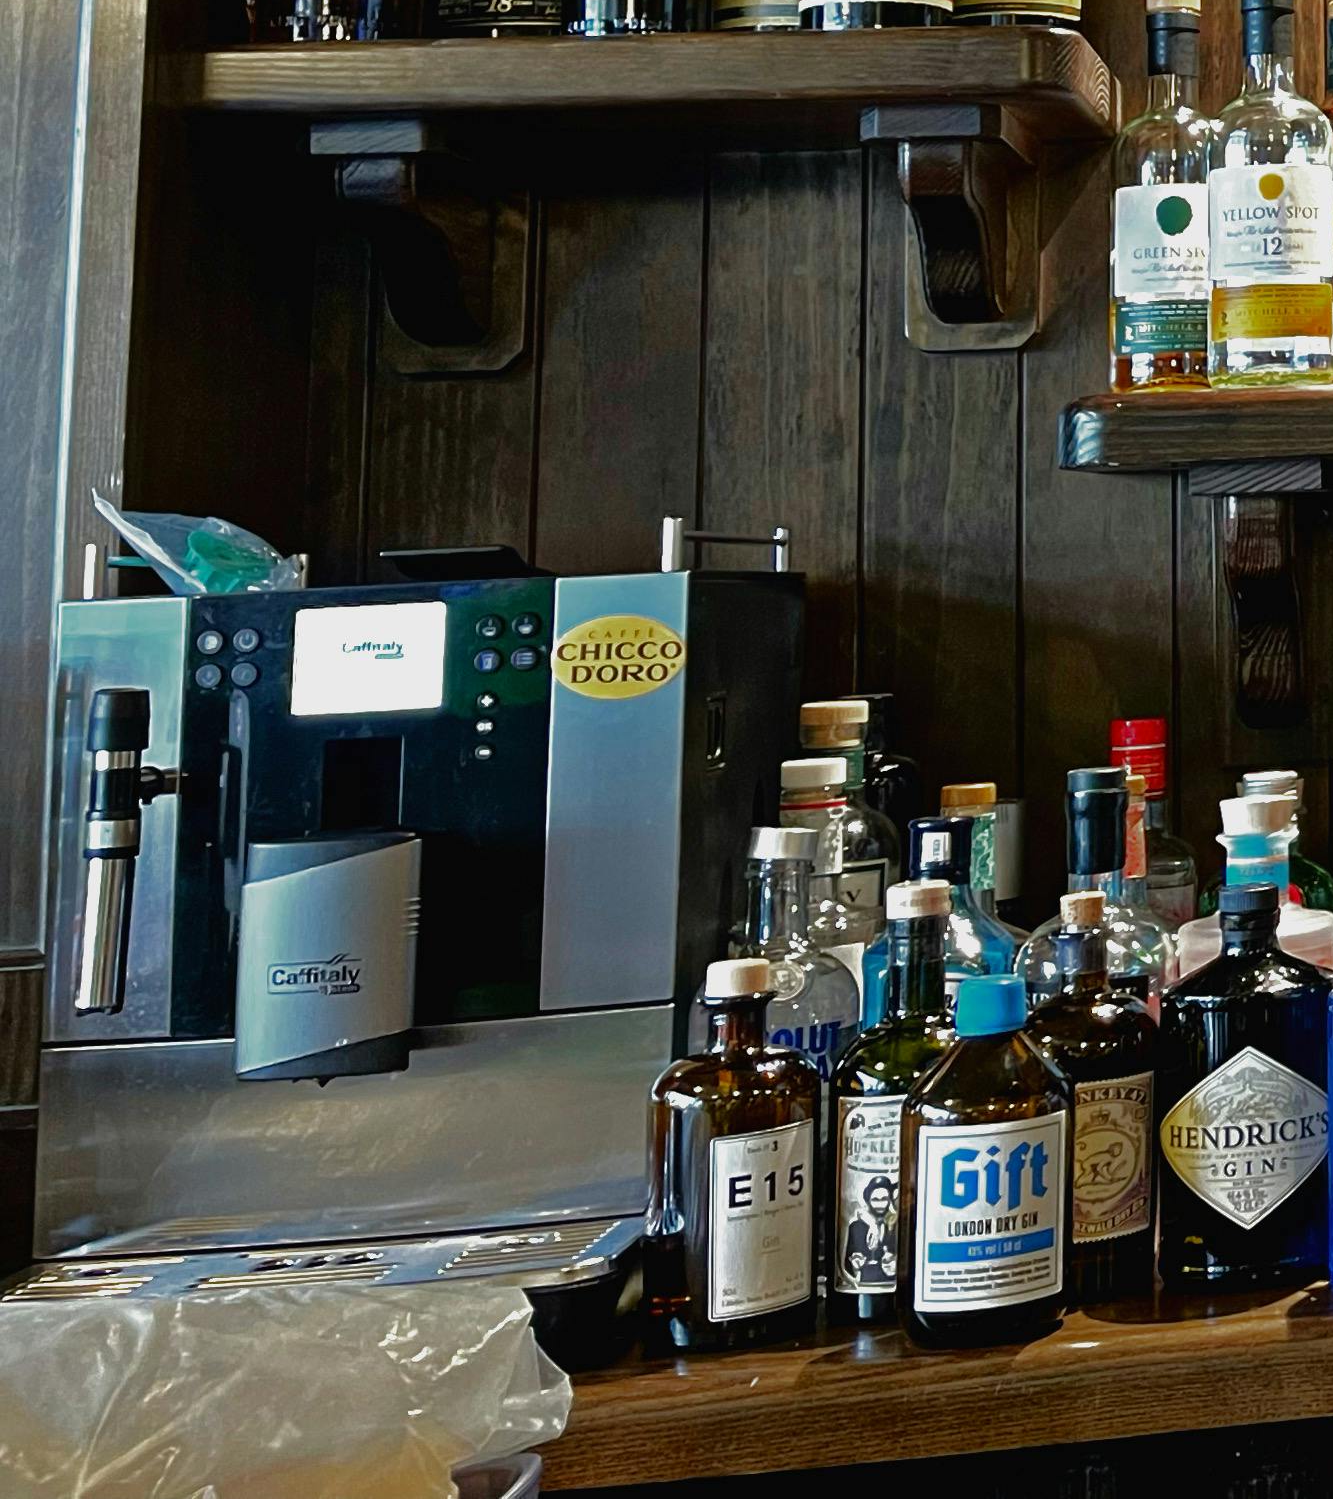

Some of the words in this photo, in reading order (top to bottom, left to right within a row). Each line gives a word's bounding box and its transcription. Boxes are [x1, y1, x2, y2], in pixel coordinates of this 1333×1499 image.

[1223, 206, 1281, 222] YELLOW
[1286, 207, 1319, 220] SPOT
[1134, 247, 1180, 259] GREEN
[1186, 247, 1205, 258] SP
[1262, 237, 1282, 256] 12
[557, 641, 682, 661] CHICCO
[571, 663, 668, 683] D'ORO
[476, 722, 493, 731] OK
[272, 965, 360, 985] Caffitaly
[766, 1021, 843, 1051] OLUT
[1078, 1087, 1127, 1100] NKEY
[1170, 1111, 1329, 1149] HENDRICK'S
[771, 1140, 778, 1152] 3
[940, 1141, 1048, 1211] Gift
[1223, 1157, 1276, 1177] GIN
[948, 1219, 992, 1238] LONDON
[997, 1217, 1017, 1232] DRY
[1021, 1211, 1038, 1229] GIN
[762, 1237, 780, 1249] Gin
